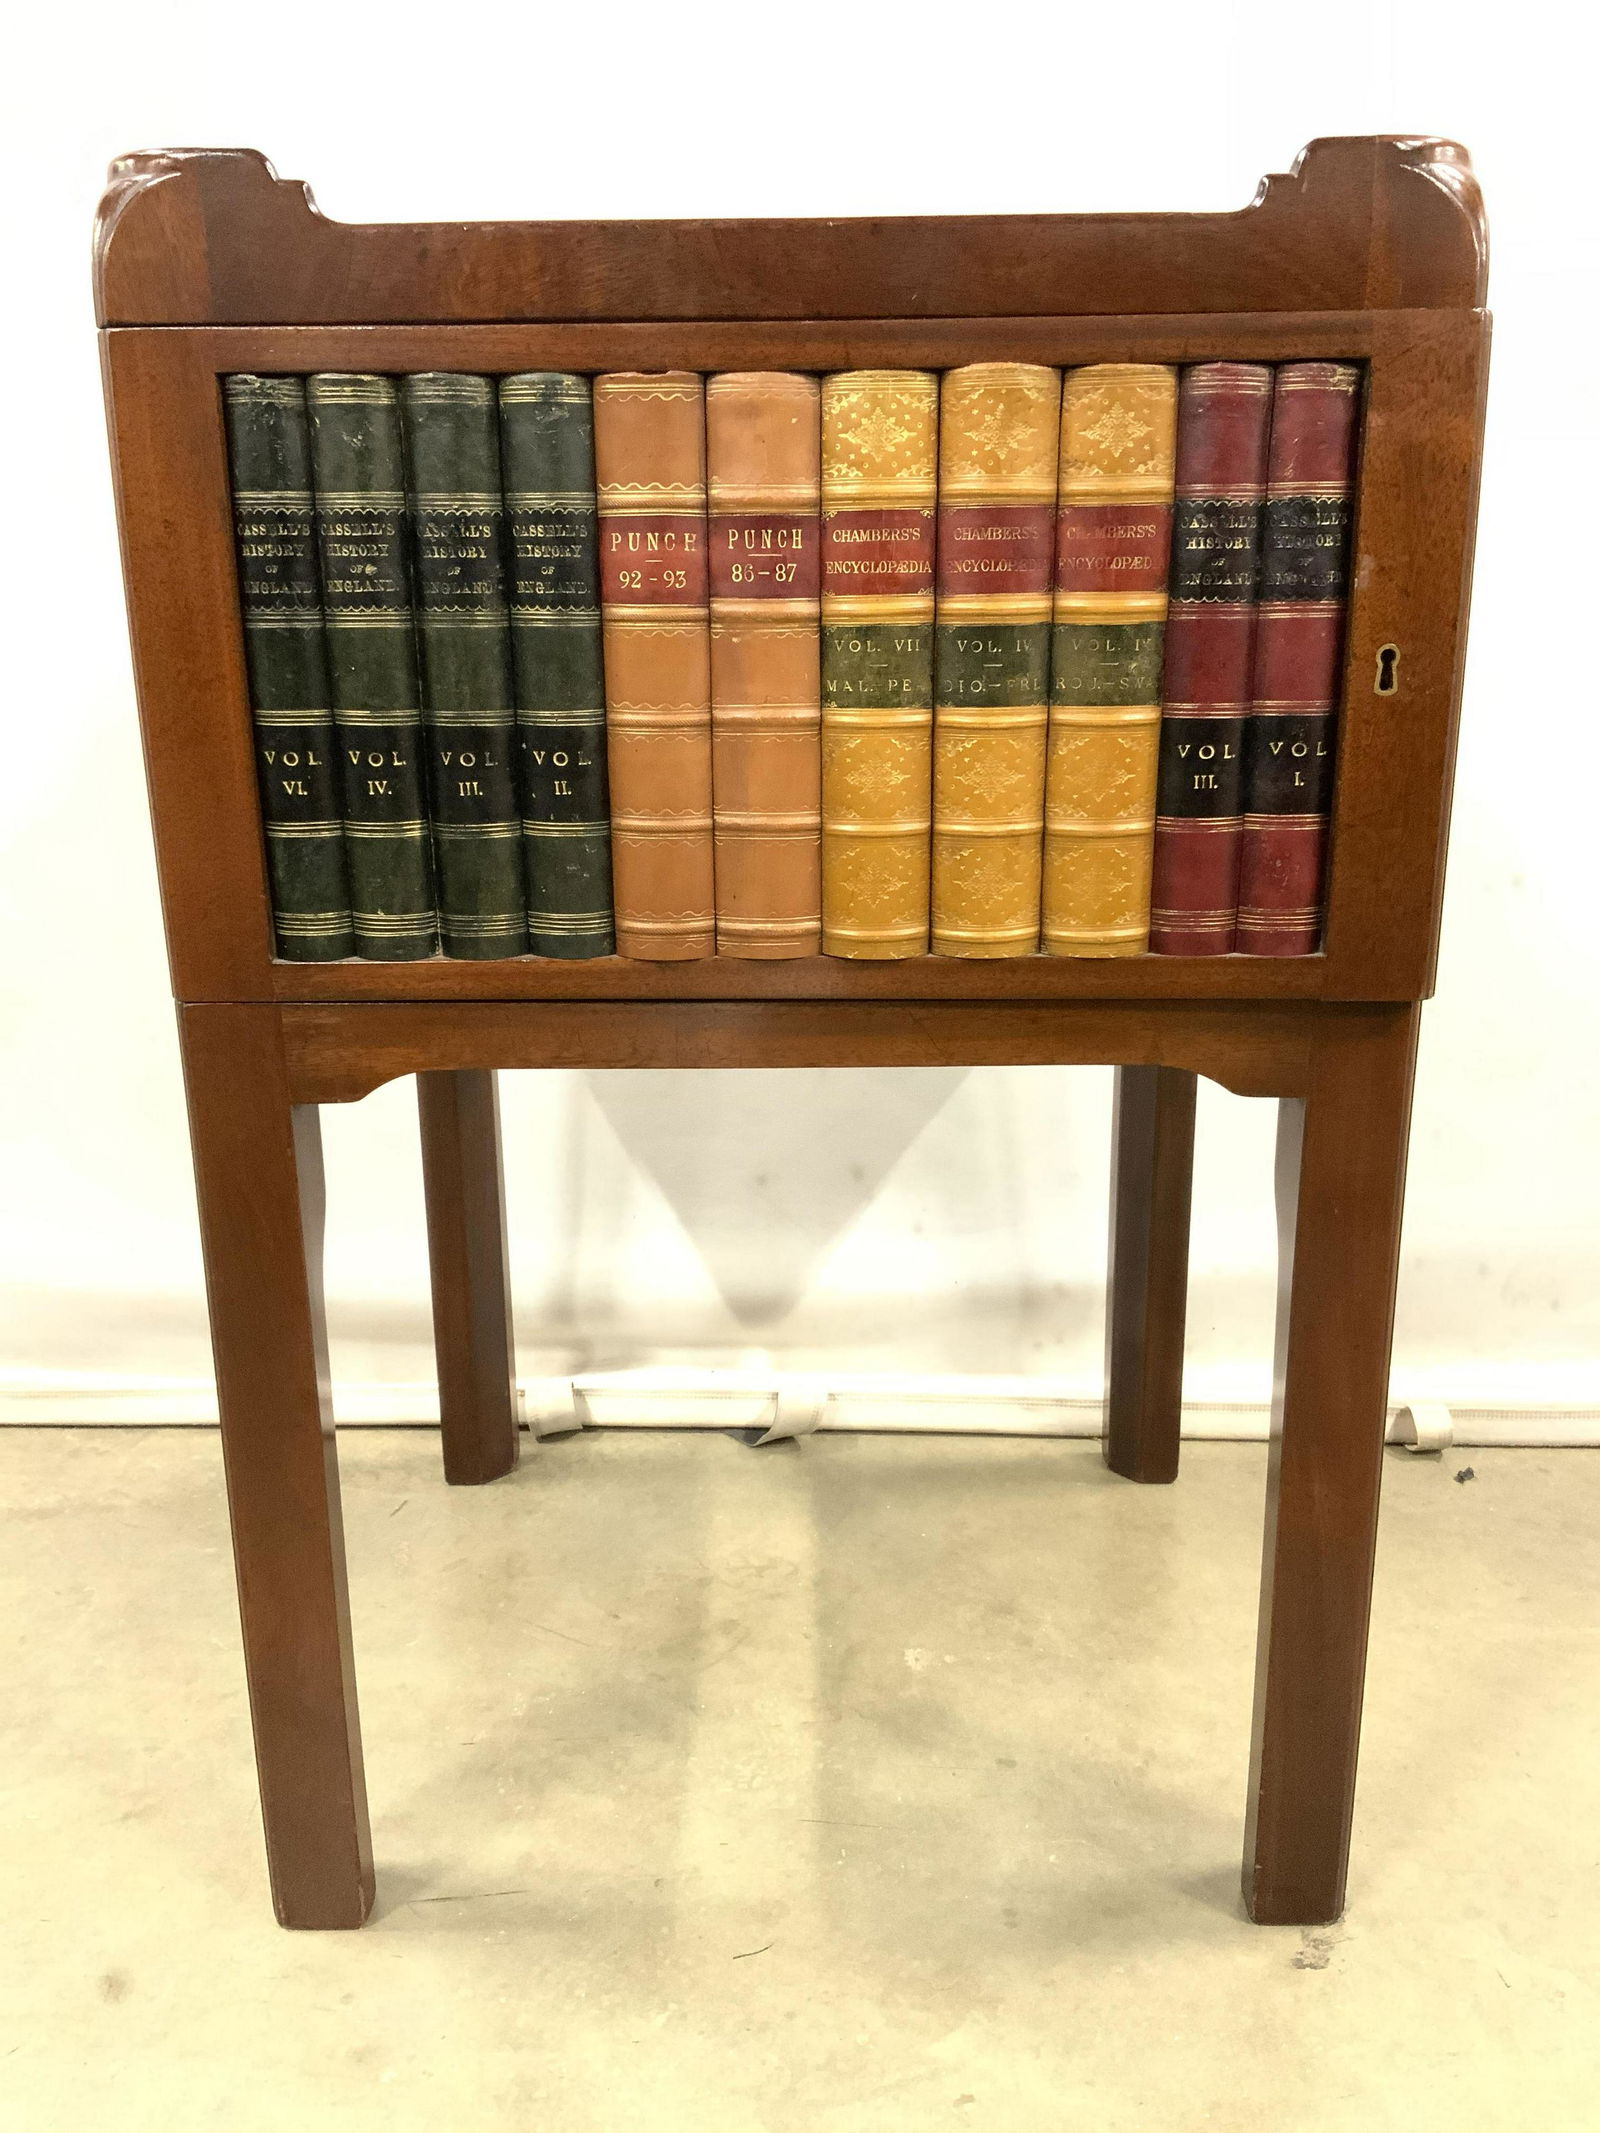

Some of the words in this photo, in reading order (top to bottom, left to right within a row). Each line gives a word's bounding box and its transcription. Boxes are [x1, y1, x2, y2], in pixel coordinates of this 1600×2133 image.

[320, 522, 395, 536] CASSELL'S
[417, 523, 492, 538] CASSLL'S
[512, 524, 588, 538] CASSELL'S
[832, 527, 921, 543] CHAMBERS'S
[953, 526, 1040, 541] CHAMBERS'S
[610, 532, 697, 552] PUNCH
[727, 528, 803, 550] PUNCH
[1185, 536, 1252, 550] HISTORY
[242, 543, 305, 557] HISTORY
[326, 543, 390, 557] HISTORY
[423, 545, 488, 559] HISTORY
[516, 544, 582, 558] HISTORY
[264, 564, 279, 574] OF
[349, 564, 364, 574] OF
[540, 566, 556, 575] OF
[834, 639, 881, 653] VOL.
[894, 638, 921, 652] VII
[957, 639, 1003, 653] VOL.
[1071, 638, 1122, 652] VOL.
[1178, 744, 1237, 760] VOL.
[1268, 741, 1328, 758] VOL.
[264, 751, 323, 767] VOL.
[348, 751, 407, 767] VOL.
[440, 751, 499, 767] VOL.
[532, 750, 593, 767] VOL.
[1193, 774, 1219, 790] III.
[1294, 771, 1306, 787] I.
[282, 781, 309, 796] VI.
[367, 780, 393, 796] IV.
[458, 781, 484, 797] III.
[554, 780, 573, 796] II.
